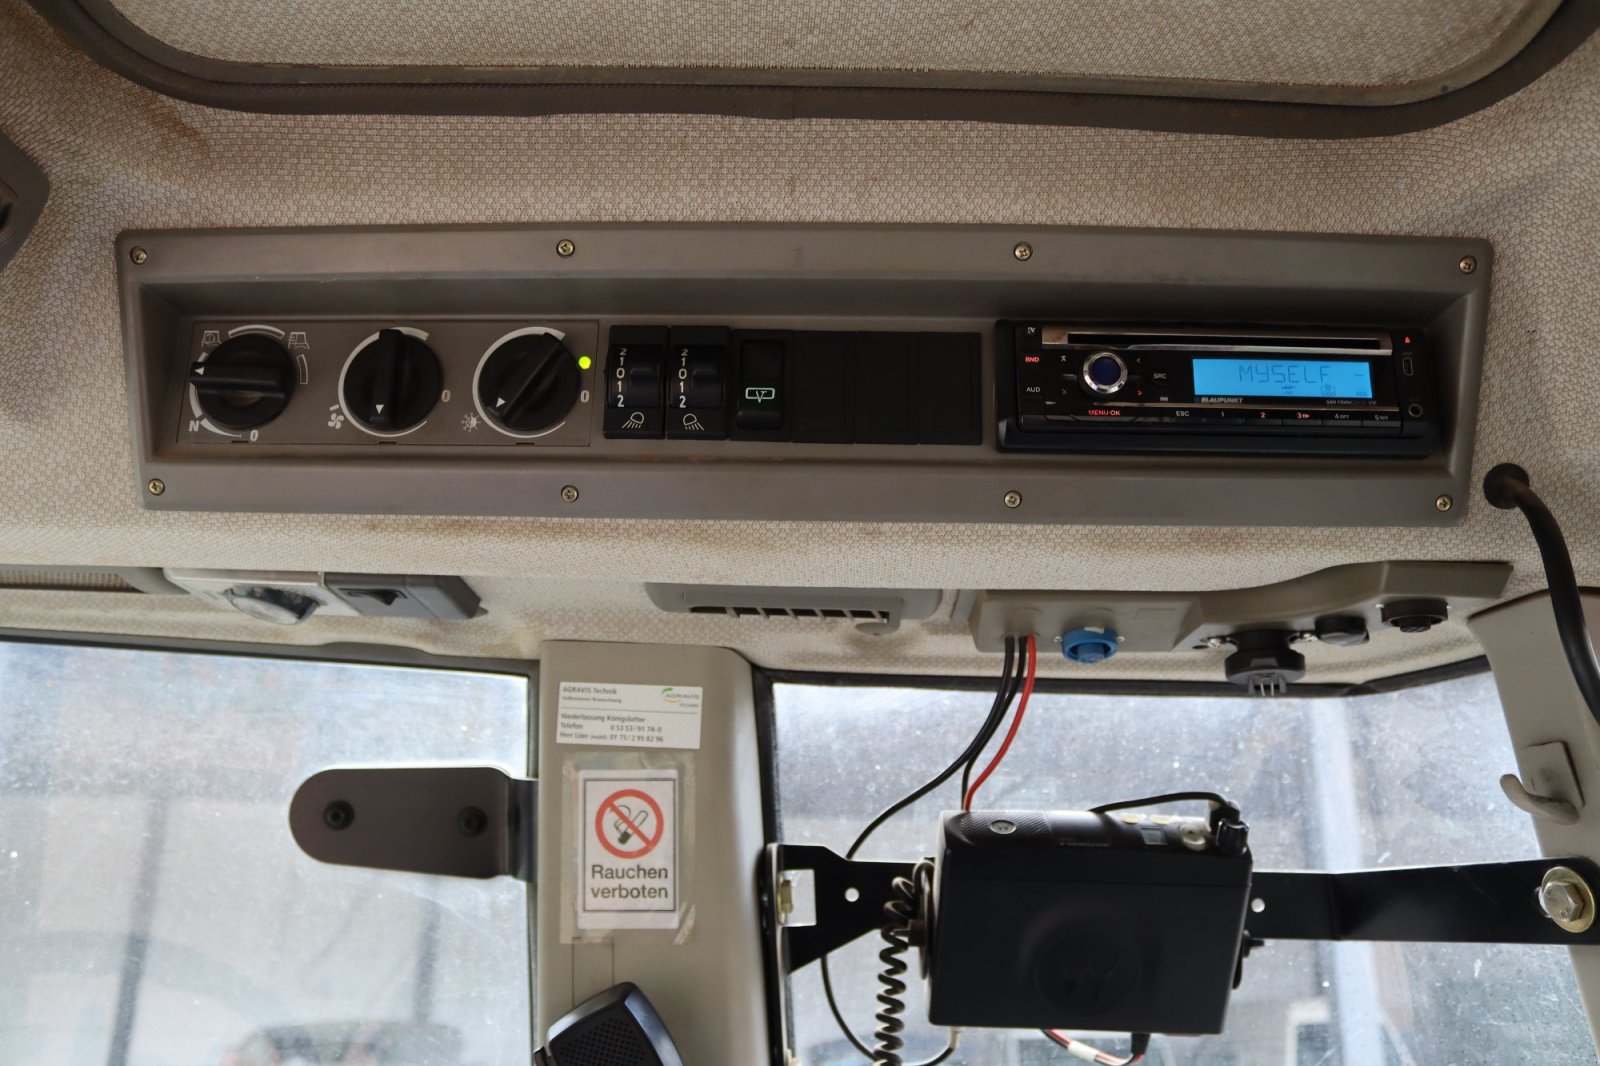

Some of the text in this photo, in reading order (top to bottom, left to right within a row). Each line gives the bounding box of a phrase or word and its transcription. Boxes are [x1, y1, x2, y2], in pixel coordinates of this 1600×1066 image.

[619, 348, 627, 356] 2
[620, 357, 625, 366] 1
[681, 358, 686, 367] 1
[616, 367, 625, 378] 0
[678, 368, 687, 380] 0
[1238, 364, 1331, 383] MYSELF
[617, 381, 622, 393] 1
[679, 382, 684, 394] 1
[441, 389, 451, 402] 0
[580, 389, 590, 403] 0
[617, 395, 625, 407] 2
[679, 395, 687, 408] 2
[1201, 396, 1244, 404] BLAUPUNKT
[249, 429, 259, 442] 0
[562, 686, 617, 695] AGRAVIS Technik
[560, 713, 605, 723] Niederlassung
[560, 722, 584, 730] Telefon
[591, 864, 668, 880] Rauchen
[591, 884, 668, 899] verboten
